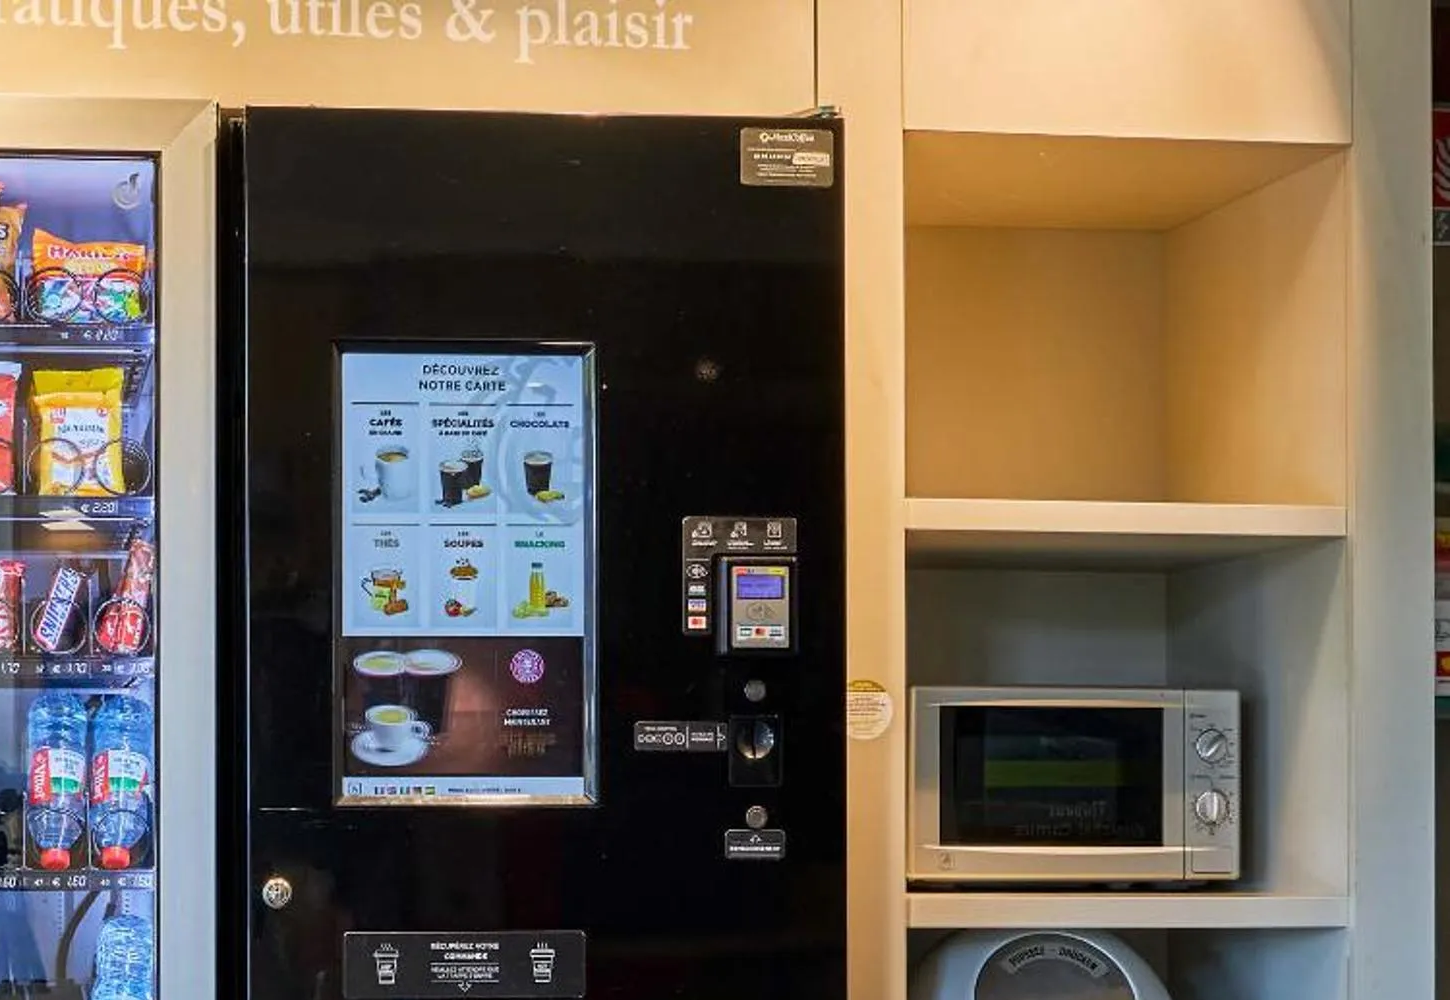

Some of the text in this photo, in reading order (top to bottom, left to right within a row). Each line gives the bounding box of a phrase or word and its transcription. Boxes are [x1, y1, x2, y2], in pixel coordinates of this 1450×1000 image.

[268, 0, 422, 38] utiles
[445, 0, 496, 43] &
[515, 0, 693, 65] plaisir
[423, 363, 500, 376] DÉCOUVREZ
[419, 381, 506, 392] NOTRE CARTE
[432, 417, 495, 428] SPÉCIALITÉS
[374, 537, 400, 548] THÉS
[444, 540, 484, 548] SOUPES
